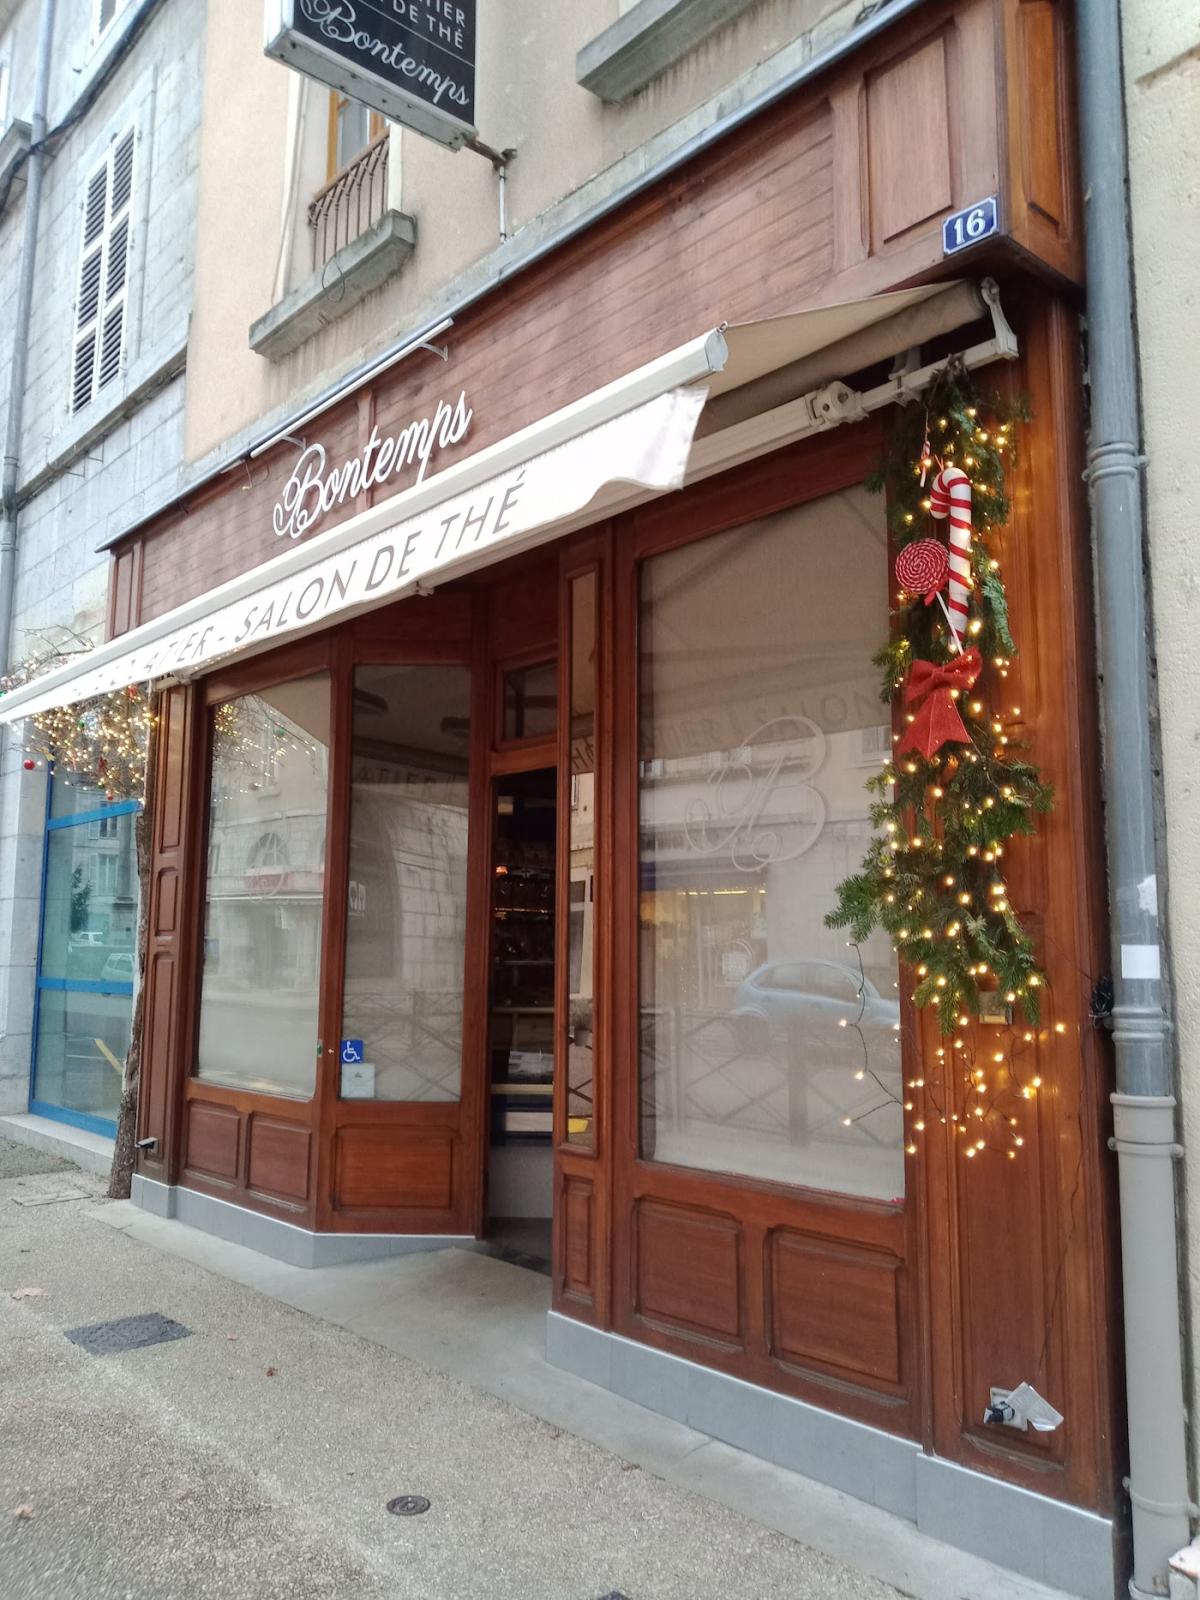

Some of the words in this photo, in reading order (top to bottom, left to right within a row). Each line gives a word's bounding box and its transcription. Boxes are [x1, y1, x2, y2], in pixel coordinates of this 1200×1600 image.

[300, 0, 470, 105] Bontemps
[426, 14, 463, 50] THÉ
[954, 209, 985, 245] 16
[273, 390, 473, 539] Bontemps
[234, 560, 357, 643] SALON
[365, 530, 422, 591] DE
[434, 470, 527, 559] THÉ
